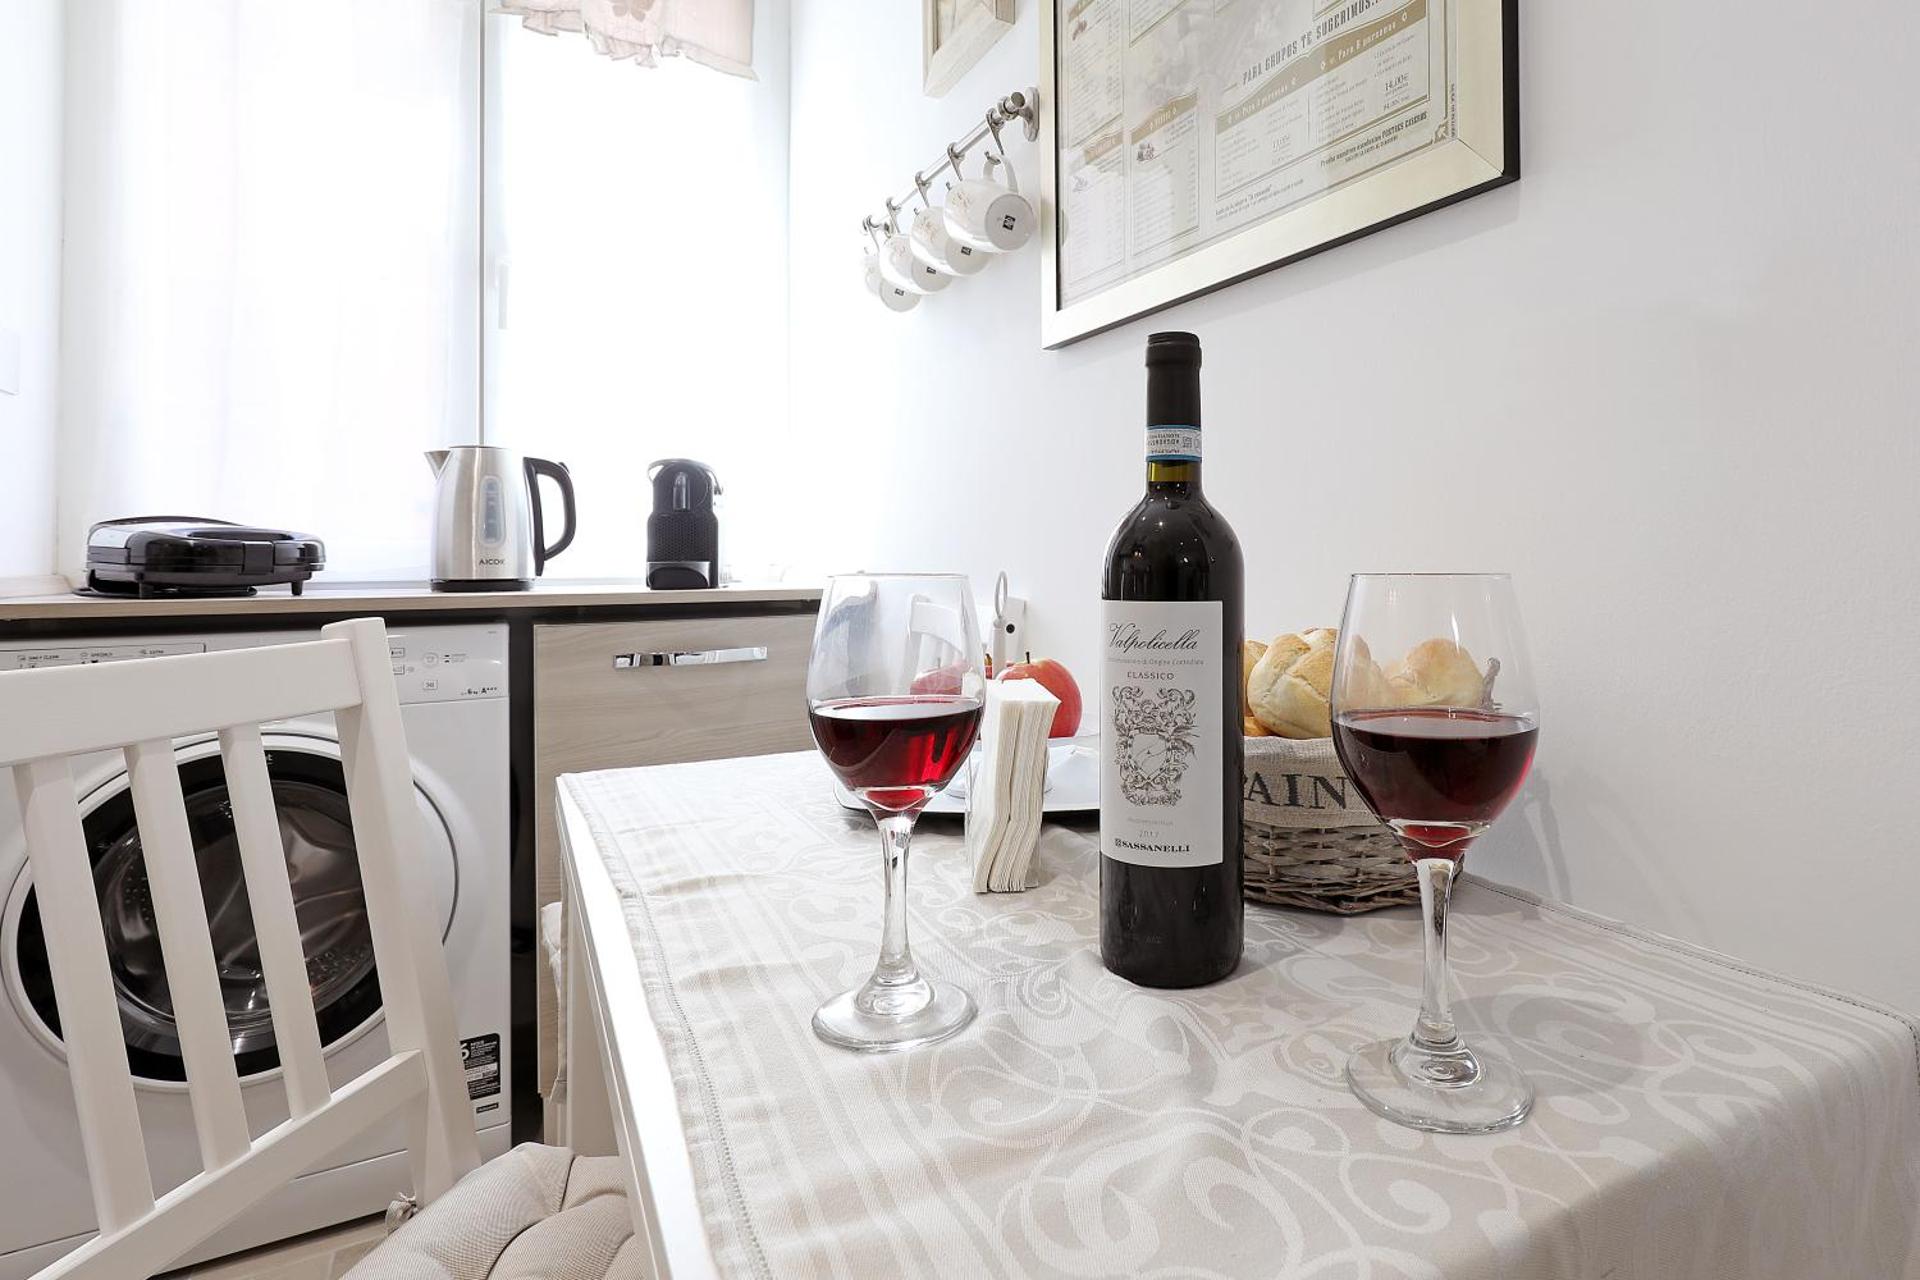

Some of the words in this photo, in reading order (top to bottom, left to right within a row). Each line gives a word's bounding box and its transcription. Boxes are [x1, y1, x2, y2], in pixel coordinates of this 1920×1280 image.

[1243, 62, 1262, 85] PARA
[1265, 41, 1298, 71] GRUPOS
[1301, 31, 1313, 48] TE
[1109, 622, 1200, 654] Valpolicella
[1127, 671, 1175, 681] CLASSICO
[1243, 771, 1349, 809] AIN
[1122, 841, 1190, 852] SASSANELLI
